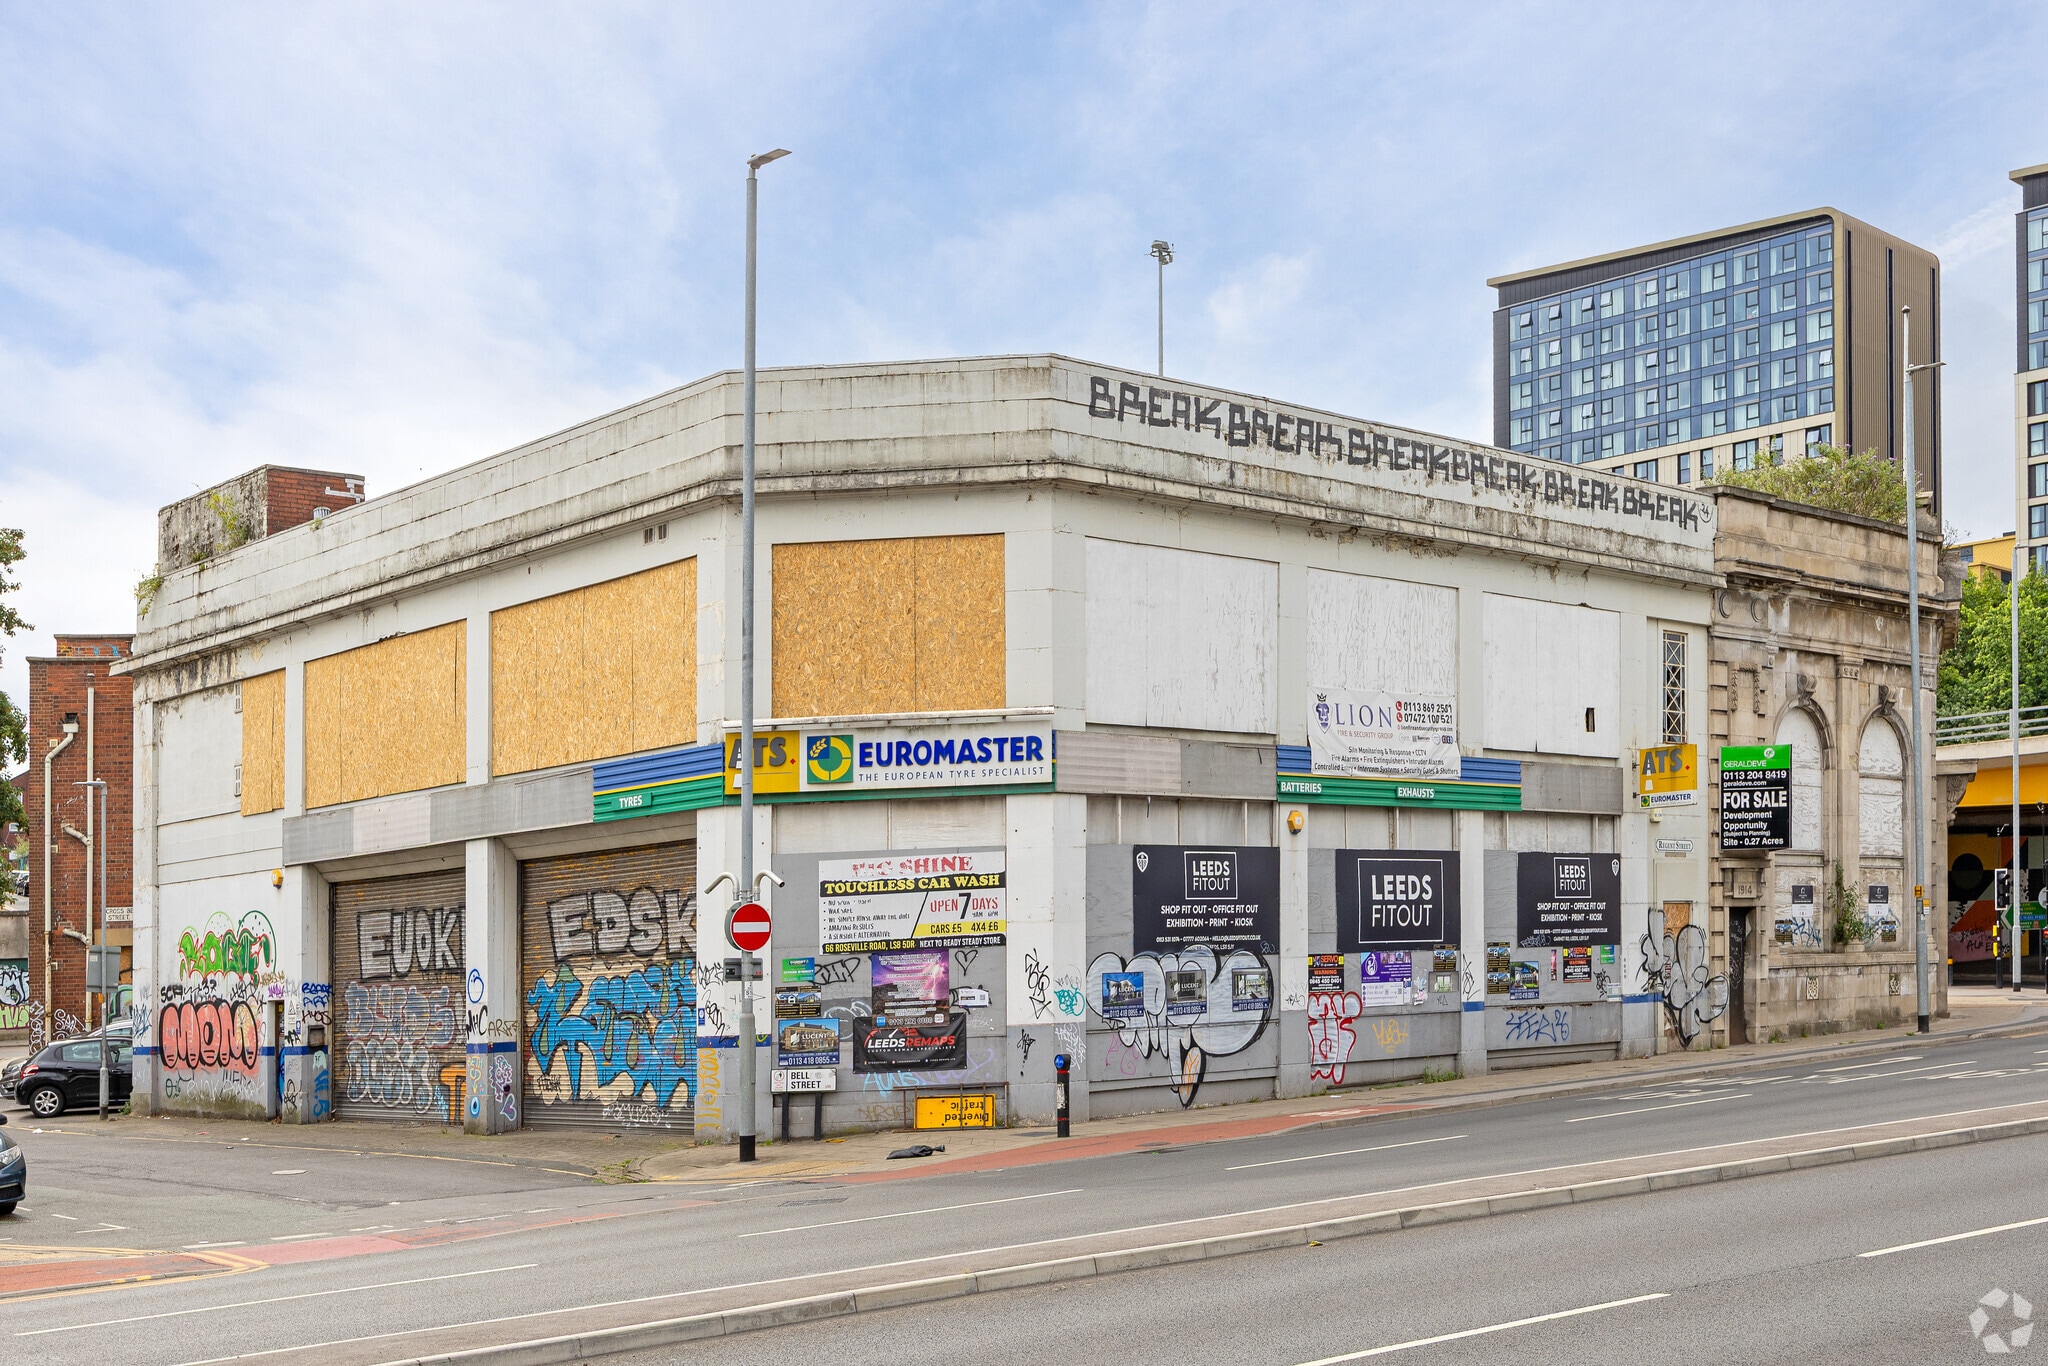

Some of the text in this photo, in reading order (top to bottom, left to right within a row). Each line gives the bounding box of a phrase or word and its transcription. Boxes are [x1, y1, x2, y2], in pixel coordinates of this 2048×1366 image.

[1088, 375, 1698, 533] BREAK BREAK BREAK BREAK BREAK BREAK
[1403, 701, 1435, 712] 0113 869
[1334, 702, 1392, 728] LION
[1404, 713, 1425, 723] 07472
[1440, 714, 1452, 724] 521
[1337, 729, 1348, 737] FIRE
[1353, 731, 1376, 739] SECURITY
[859, 735, 1044, 768] EUROMASTER
[1348, 746, 1357, 754] Site
[1358, 747, 1383, 756] Monitoring
[1389, 748, 1411, 757] Response
[1373, 756, 1405, 765] Extinguishers
[1428, 758, 1444, 766] Alarms
[858, 766, 1045, 782] THE EUROPEAN TYRE SPECIALIST
[1314, 762, 1340, 772] Controlled
[1380, 767, 1400, 775] Systems
[1403, 767, 1421, 776] Security
[1422, 767, 1435, 775] Gates
[1723, 770, 1787, 780] 0113 204 8419
[1280, 781, 1322, 794] BATTERIES
[1723, 780, 1767, 788] geraldeve.com
[1397, 786, 1434, 798] EXHAUSTS
[618, 794, 643, 809] TYRES
[1650, 793, 1692, 803] EUROMASTER
[1723, 790, 1787, 809] FOR SALE
[1723, 811, 1772, 820] Development
[1723, 821, 1767, 831] Opportunity
[1723, 837, 1784, 846] Site 0.27 Acres
[1192, 860, 1230, 877] LEEDS
[1559, 865, 1586, 878] LEEDS
[824, 874, 1000, 895] TOUCHLESS CAR WASH
[1192, 877, 1230, 891] FITOUT
[1371, 874, 1433, 901] LEEDS
[1559, 879, 1586, 891] FITOUT
[1737, 884, 1752, 895] 1914
[930, 892, 998, 920] OPEN 7 DAYS
[1160, 904, 1259, 914] SHOP FIT OUT OFFICE FIT OUT
[1537, 902, 1552, 911] SHOP
[1551, 902, 1559, 911] FIT
[1559, 902, 1570, 910] OUT
[1573, 902, 1590, 910] OFFICE
[1596, 901, 1606, 910] OUT
[1371, 904, 1433, 928] FITOUT
[1541, 913, 1603, 922] EXHIBITION PRINT KIOSK
[930, 921, 999, 934] CARS £5 4X4 £6
[1166, 917, 1254, 928] EXHIBITION PRINT KIOSK
[825, 939, 915, 953] 66 ROSEVILLE ROAD, LS8 5DR
[919, 936, 1001, 948] NEXT TO READY STEADY STORE
[1320, 954, 1338, 963] SERVO
[1109, 1009, 1120, 1018] 0113
[788, 1056, 830, 1065] 0113 418 0855
[790, 1071, 810, 1080] BELL
[790, 1080, 822, 1090] STREET
[944, 1113, 989, 1123] Diverted
